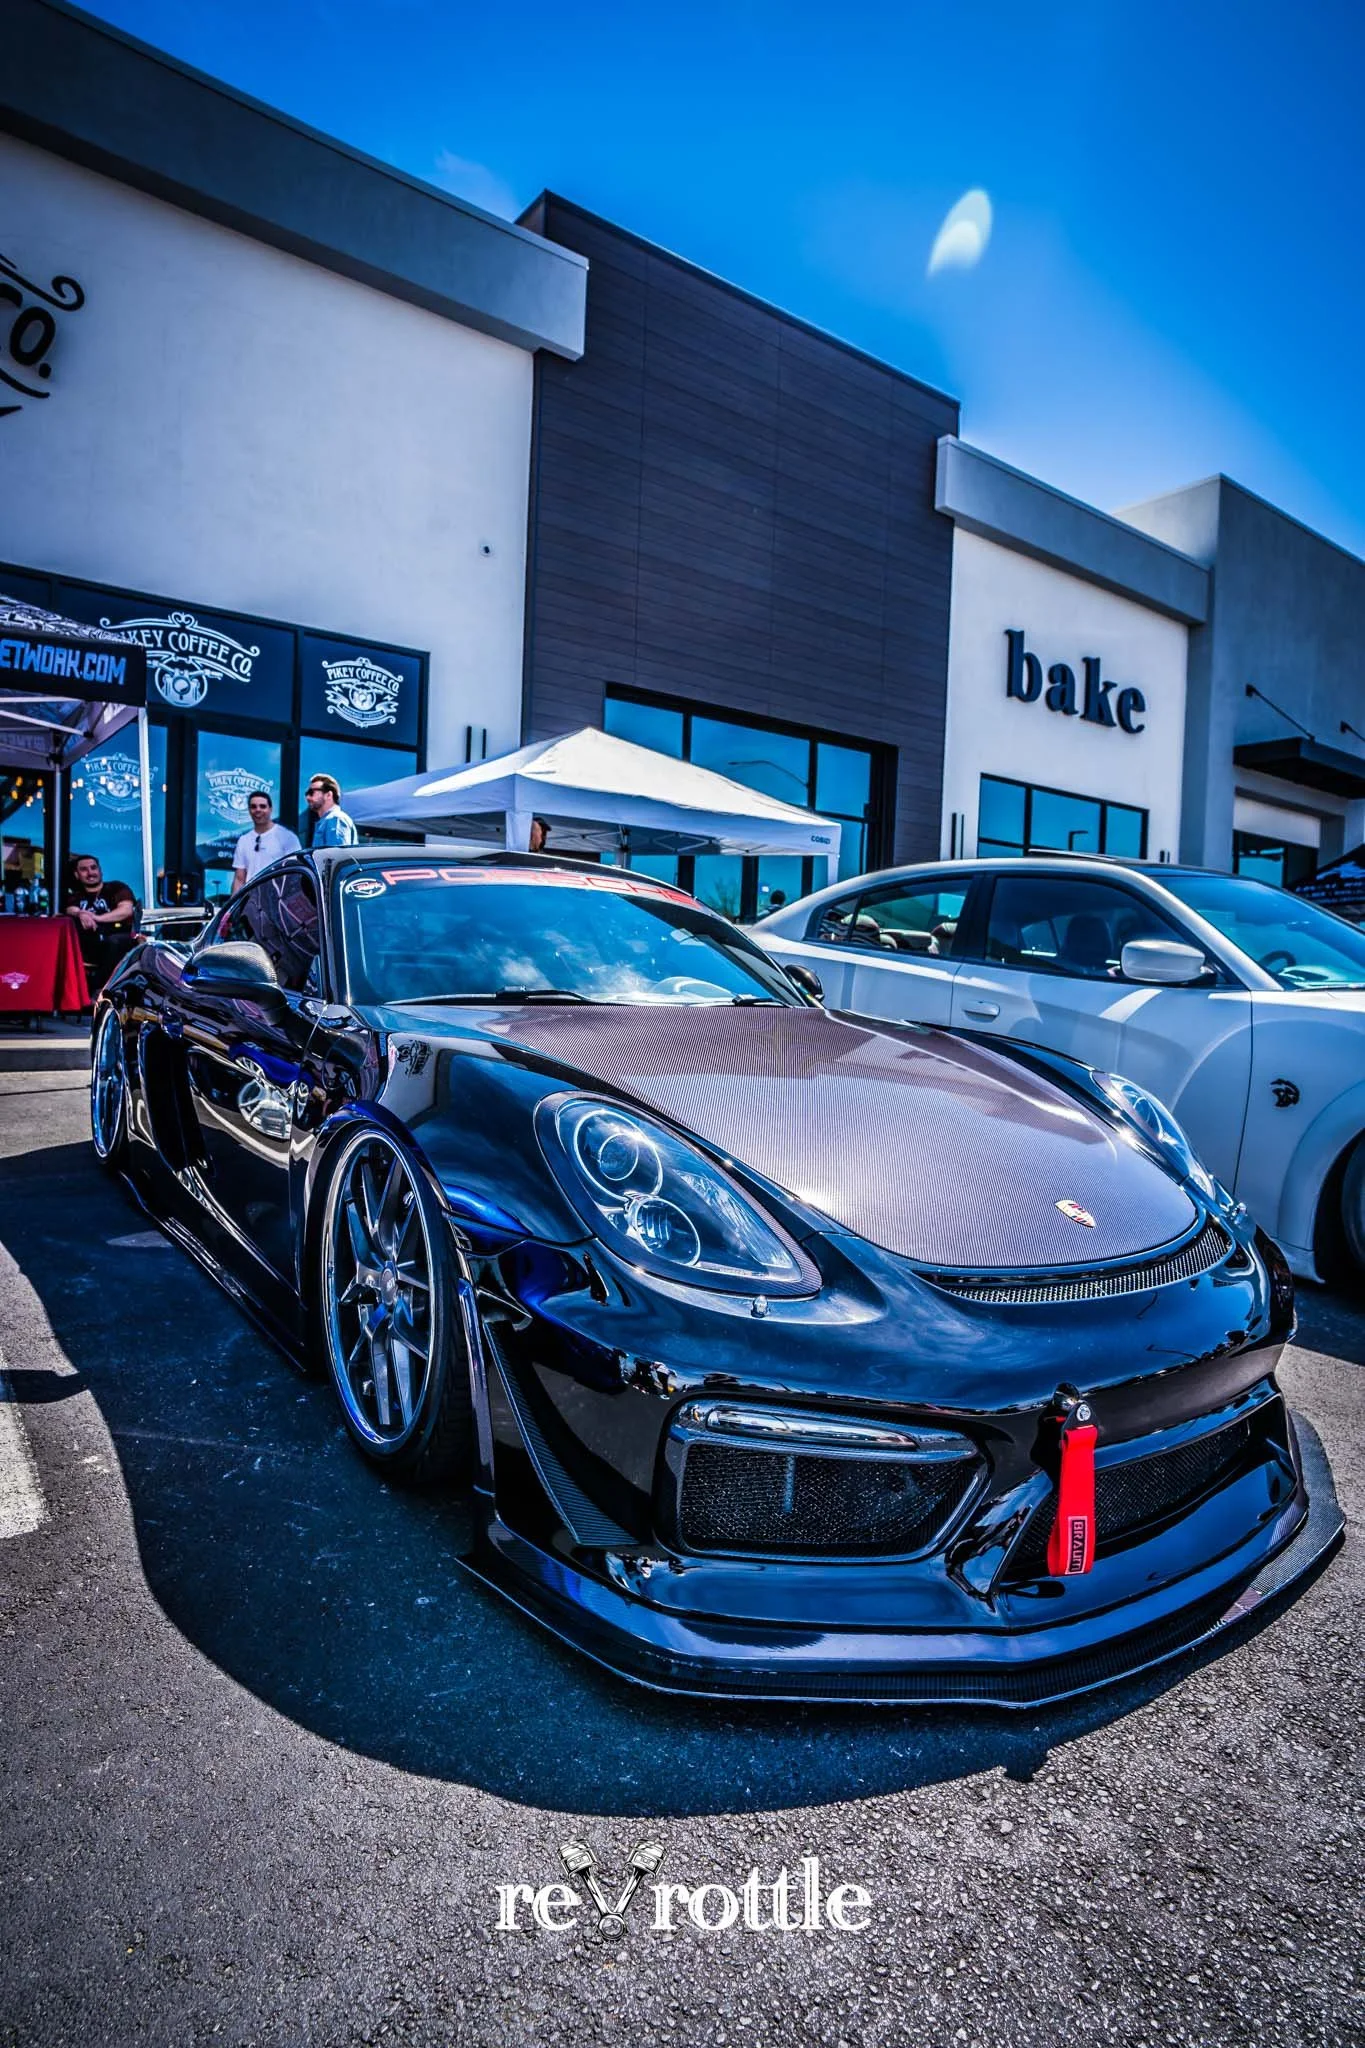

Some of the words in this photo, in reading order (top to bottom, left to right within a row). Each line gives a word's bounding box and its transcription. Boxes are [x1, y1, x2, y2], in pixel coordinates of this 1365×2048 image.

[168, 631, 229, 663] COFFEE
[326, 667, 354, 680] PIKEY
[356, 668, 388, 686] COFFEE
[1003, 629, 1146, 734] bake
[209, 776, 233, 787] PIKEY
[233, 775, 261, 789] COFFEE
[382, 869, 700, 908] PORSCHE
